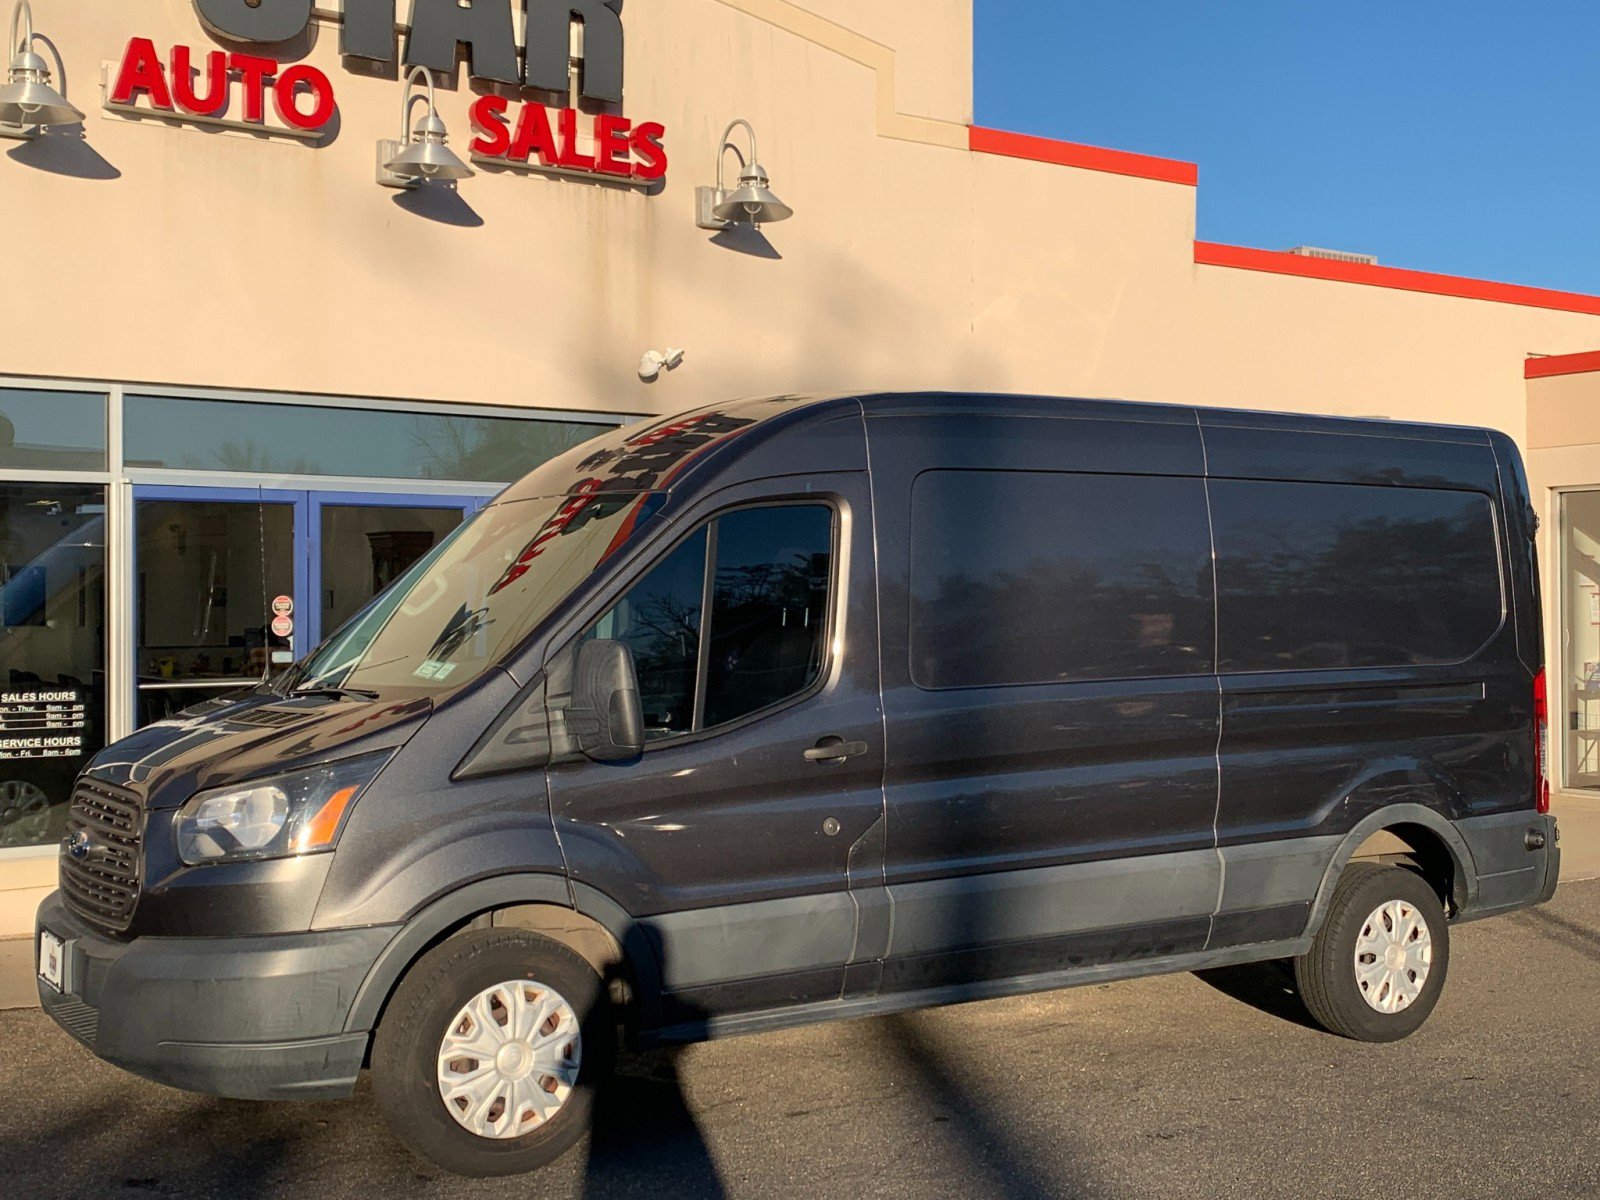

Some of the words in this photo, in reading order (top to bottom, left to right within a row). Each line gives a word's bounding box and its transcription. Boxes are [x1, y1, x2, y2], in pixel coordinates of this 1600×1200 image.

[110, 37, 334, 130] AUTO
[470, 95, 667, 181] SALES
[1, 692, 36, 702] SALES
[38, 691, 76, 701] HOURS
[43, 737, 81, 747] HOURS
